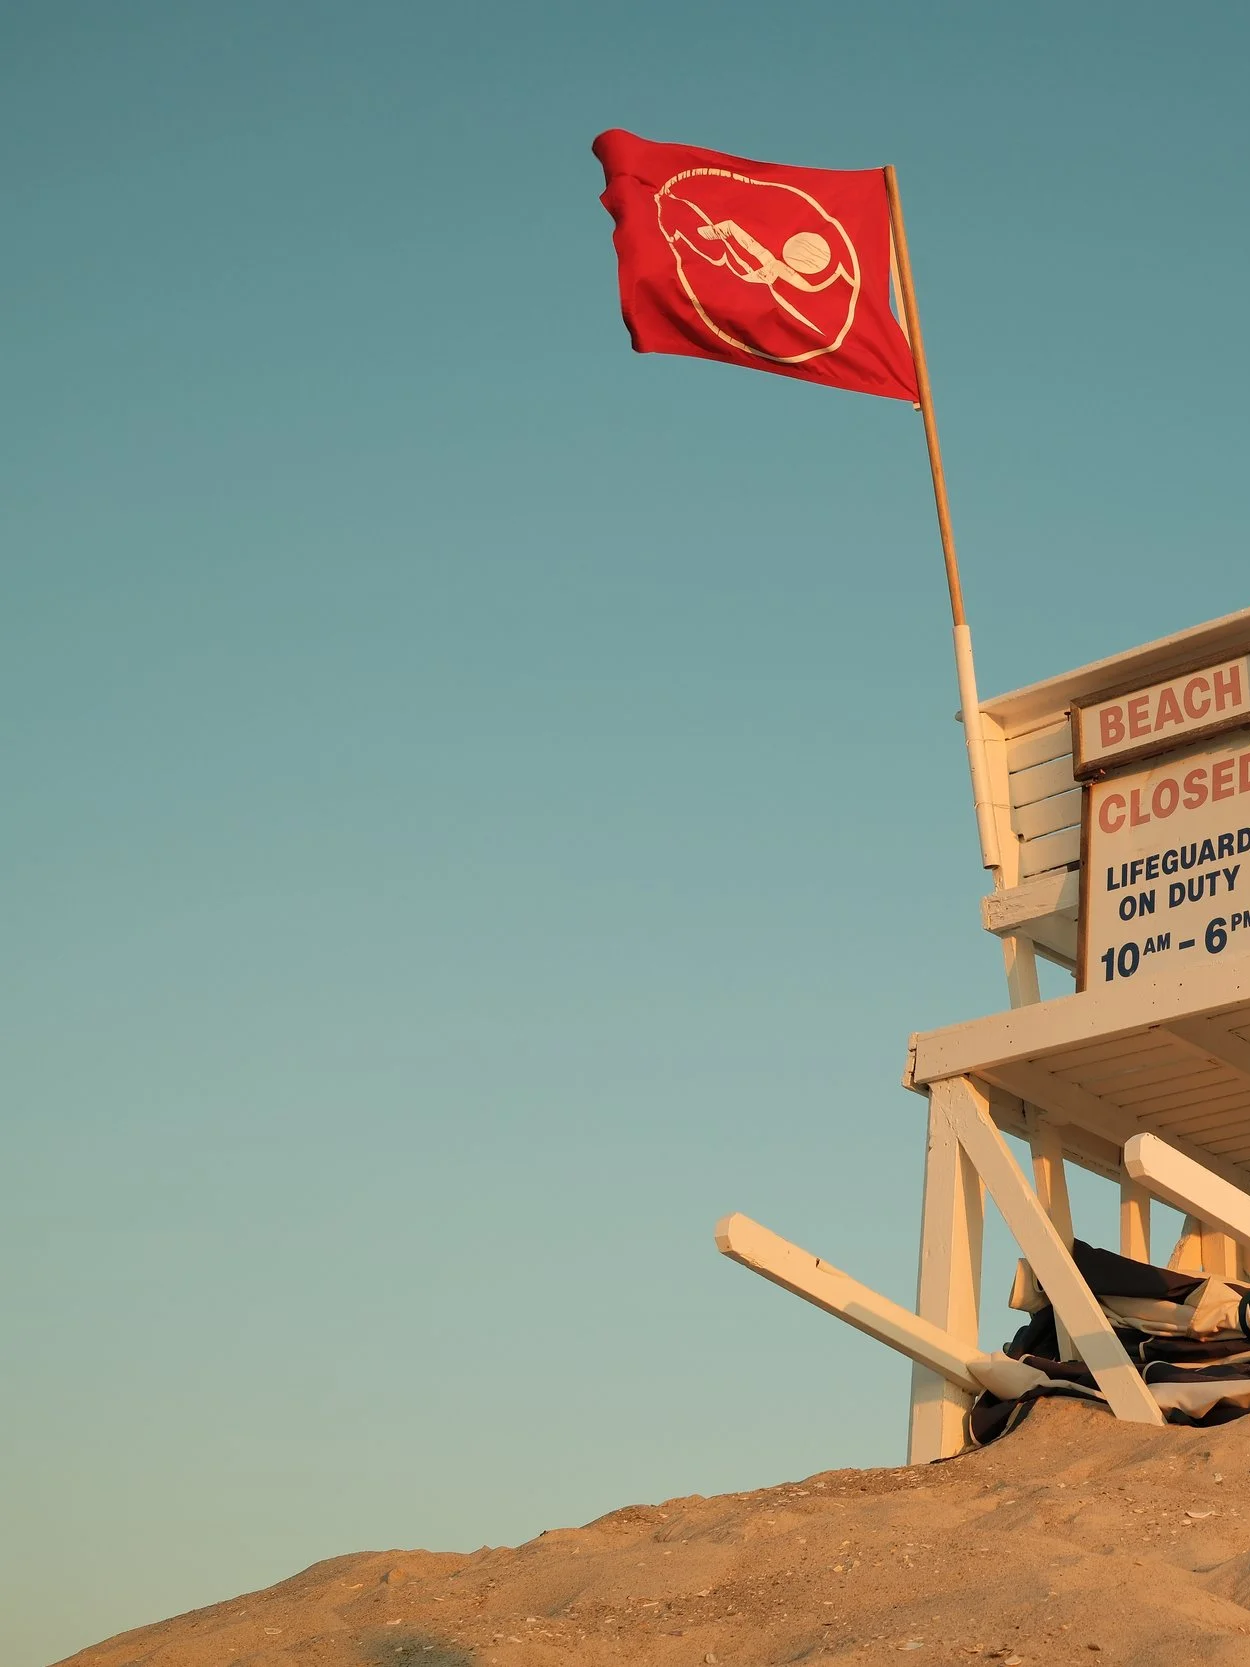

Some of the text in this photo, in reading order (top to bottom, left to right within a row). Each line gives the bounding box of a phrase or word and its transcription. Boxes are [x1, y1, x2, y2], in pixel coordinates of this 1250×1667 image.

[1099, 665, 1242, 748] BEACH
[1119, 864, 1241, 921] ON DUTY
